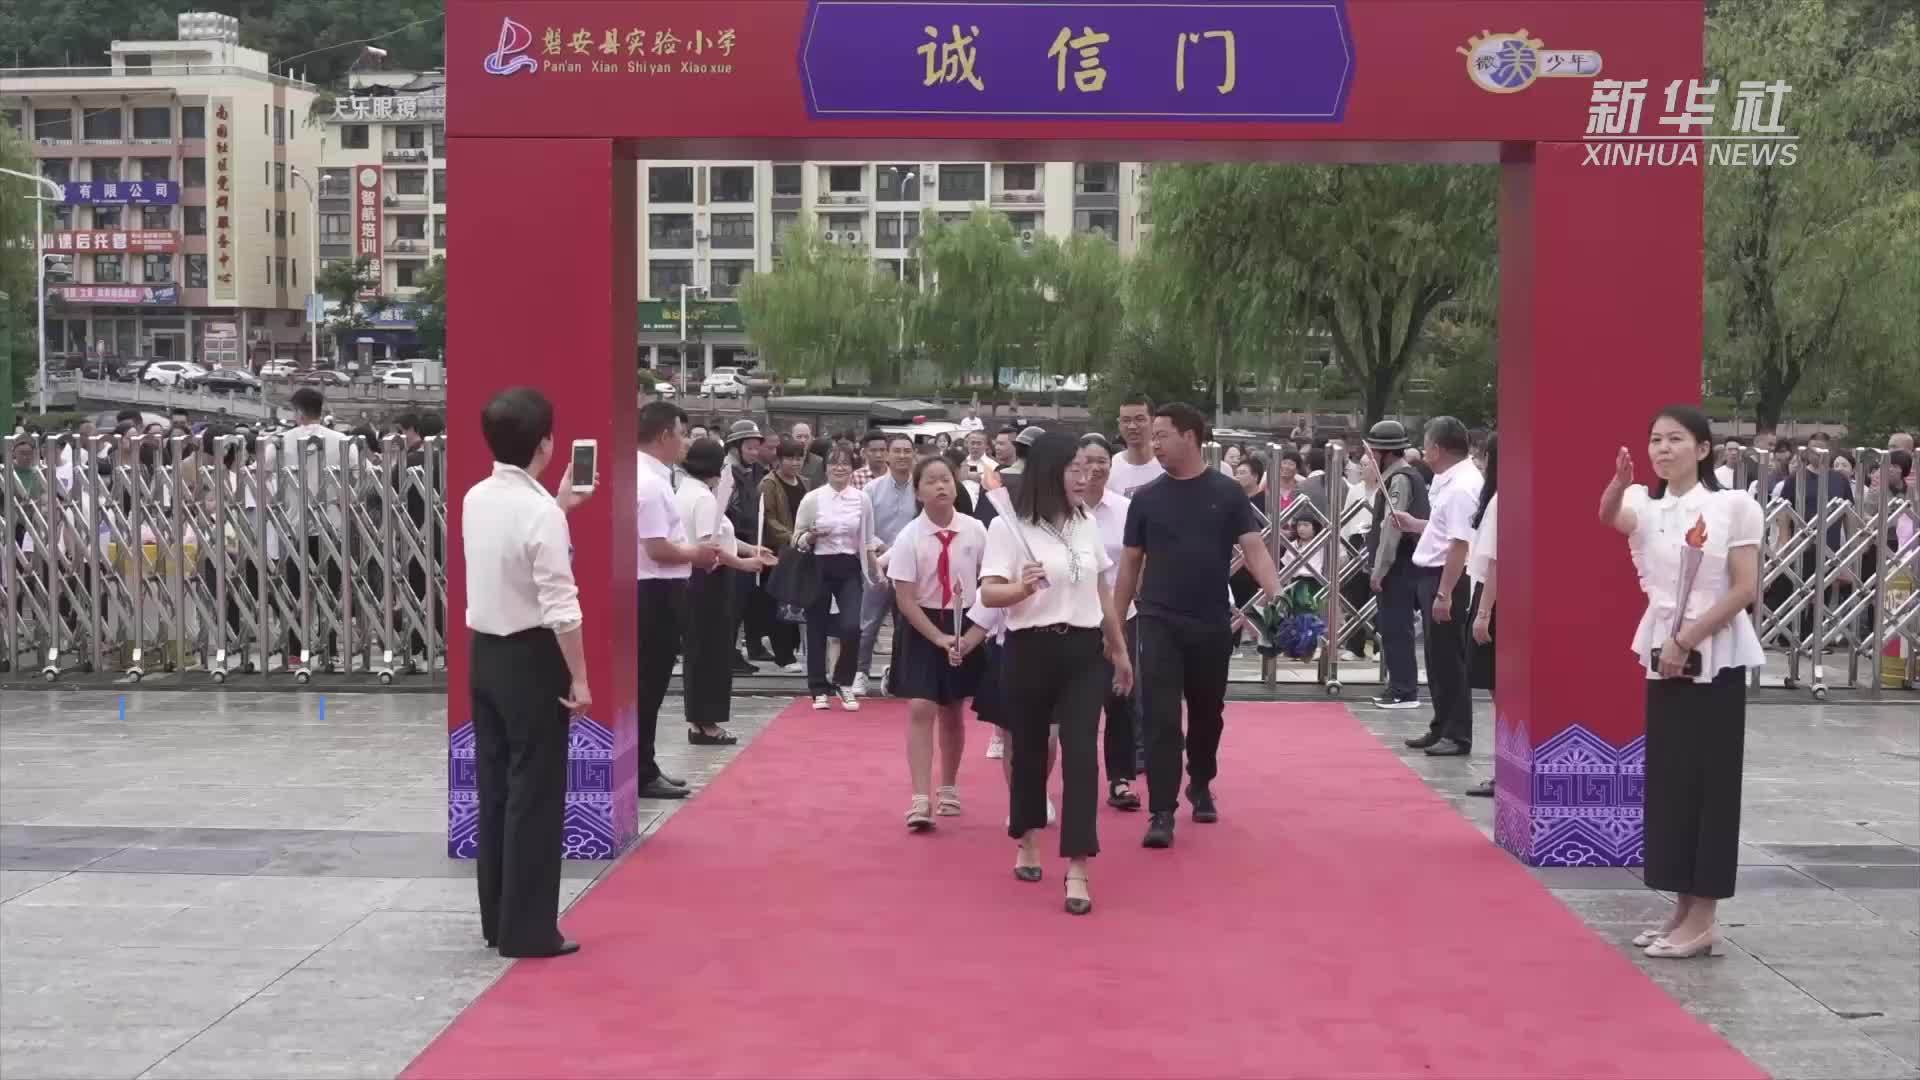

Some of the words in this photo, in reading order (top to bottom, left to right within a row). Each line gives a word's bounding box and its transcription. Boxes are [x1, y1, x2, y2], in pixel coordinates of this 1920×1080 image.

[541, 26, 737, 57] 磐安县实验小学
[543, 60, 582, 73] Pan'an
[591, 61, 618, 73] Xian
[916, 24, 1236, 94] 诚信门
